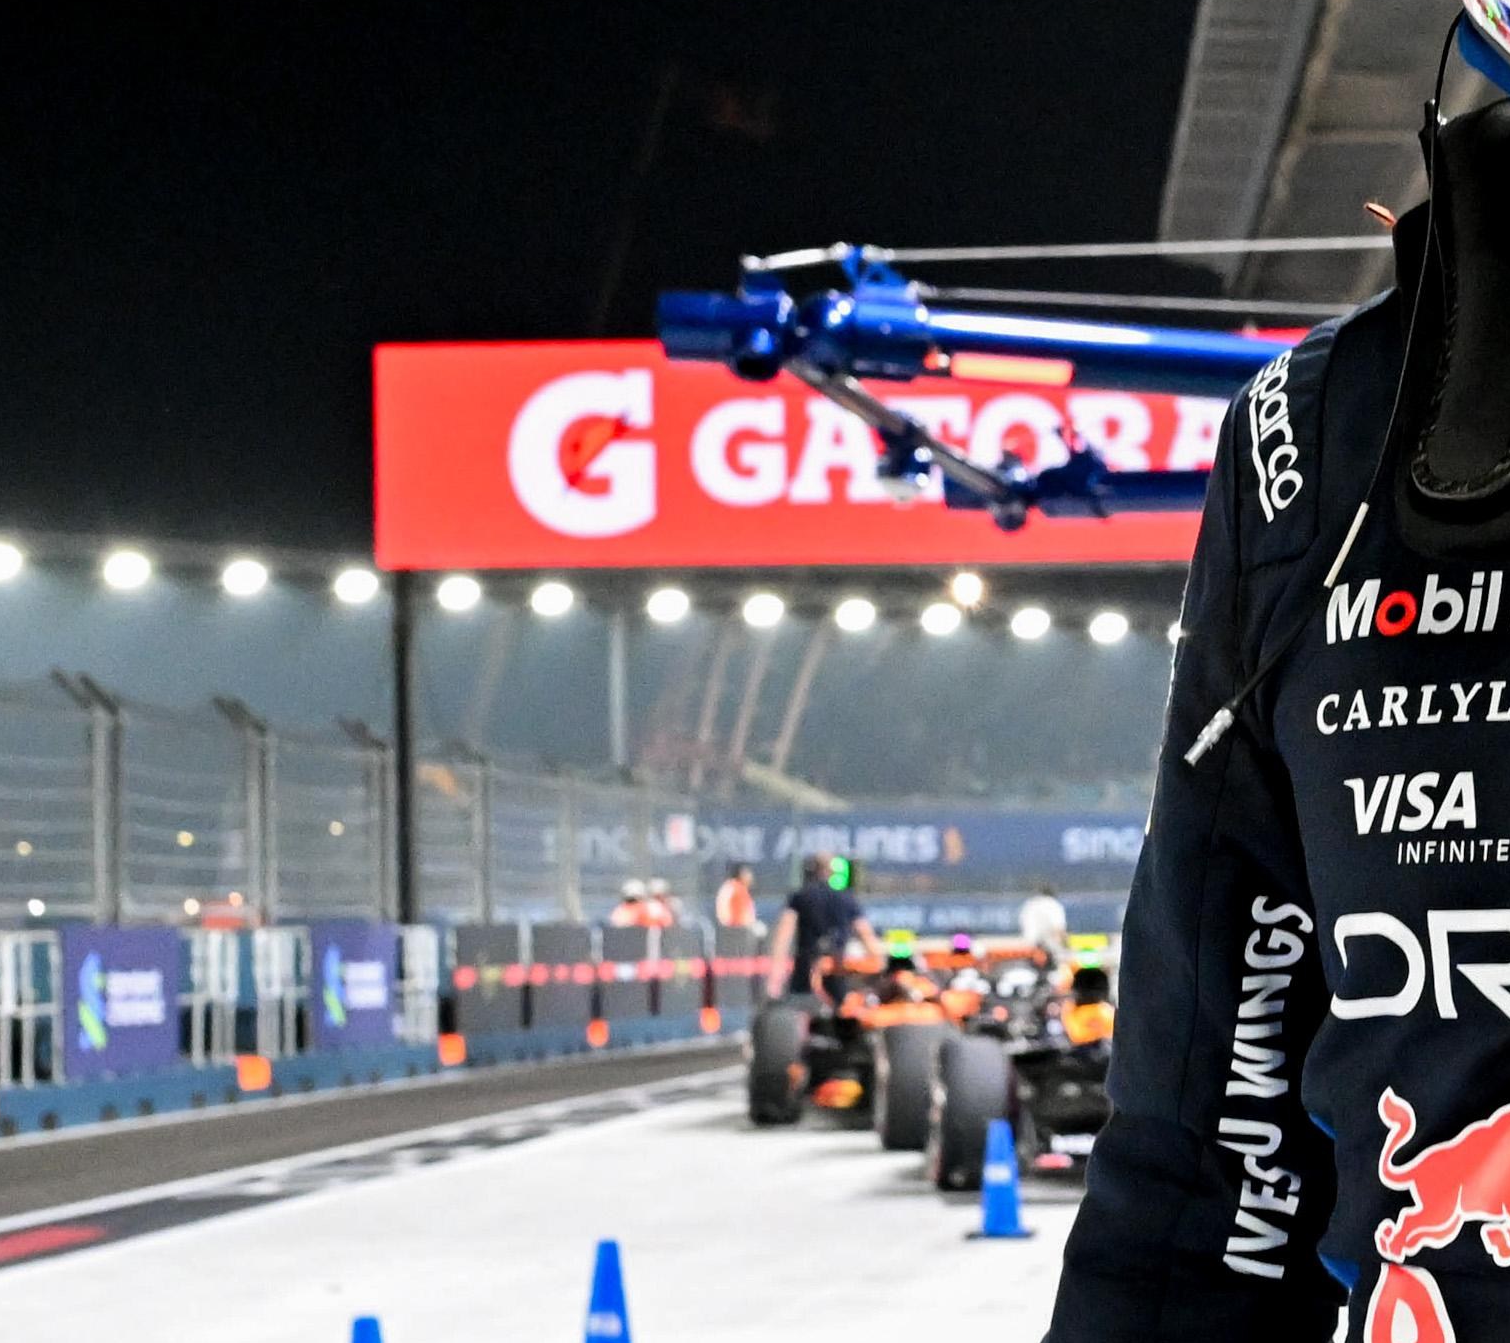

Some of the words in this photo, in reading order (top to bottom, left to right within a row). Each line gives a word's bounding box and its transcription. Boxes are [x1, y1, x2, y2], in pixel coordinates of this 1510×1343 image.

[690, 394, 1228, 507] GATORA
[1325, 570, 1502, 645] Mobil
[1344, 770, 1478, 836] VISA
[1397, 838, 1510, 865] INFINITE
[1225, 895, 1314, 1098] WINGS
